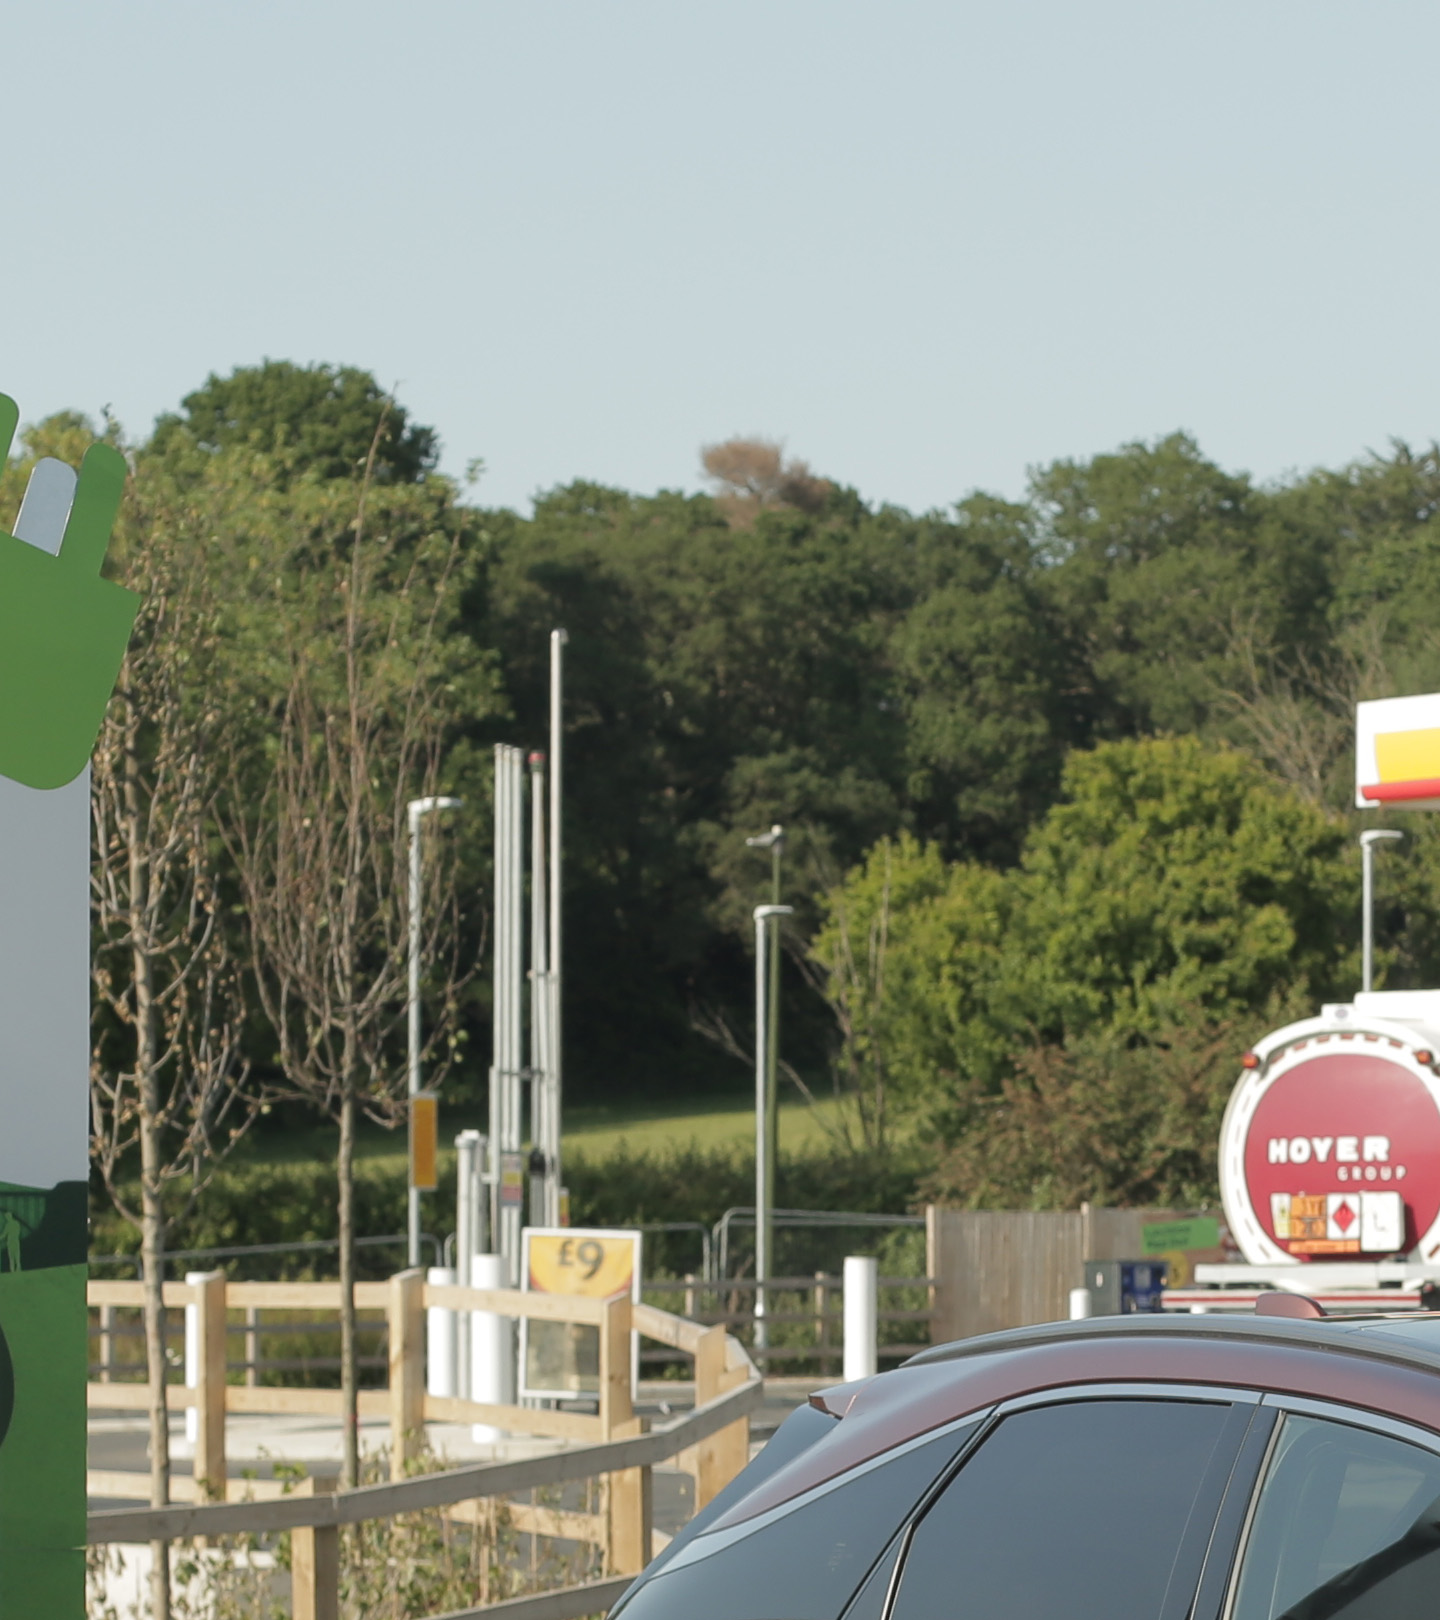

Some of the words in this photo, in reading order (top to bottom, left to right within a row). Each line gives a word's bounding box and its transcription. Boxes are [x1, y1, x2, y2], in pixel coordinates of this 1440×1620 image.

[1268, 1135, 1390, 1164] HOYER
[1336, 1165, 1407, 1182] GROUP
[558, 1239, 605, 1280] £9
